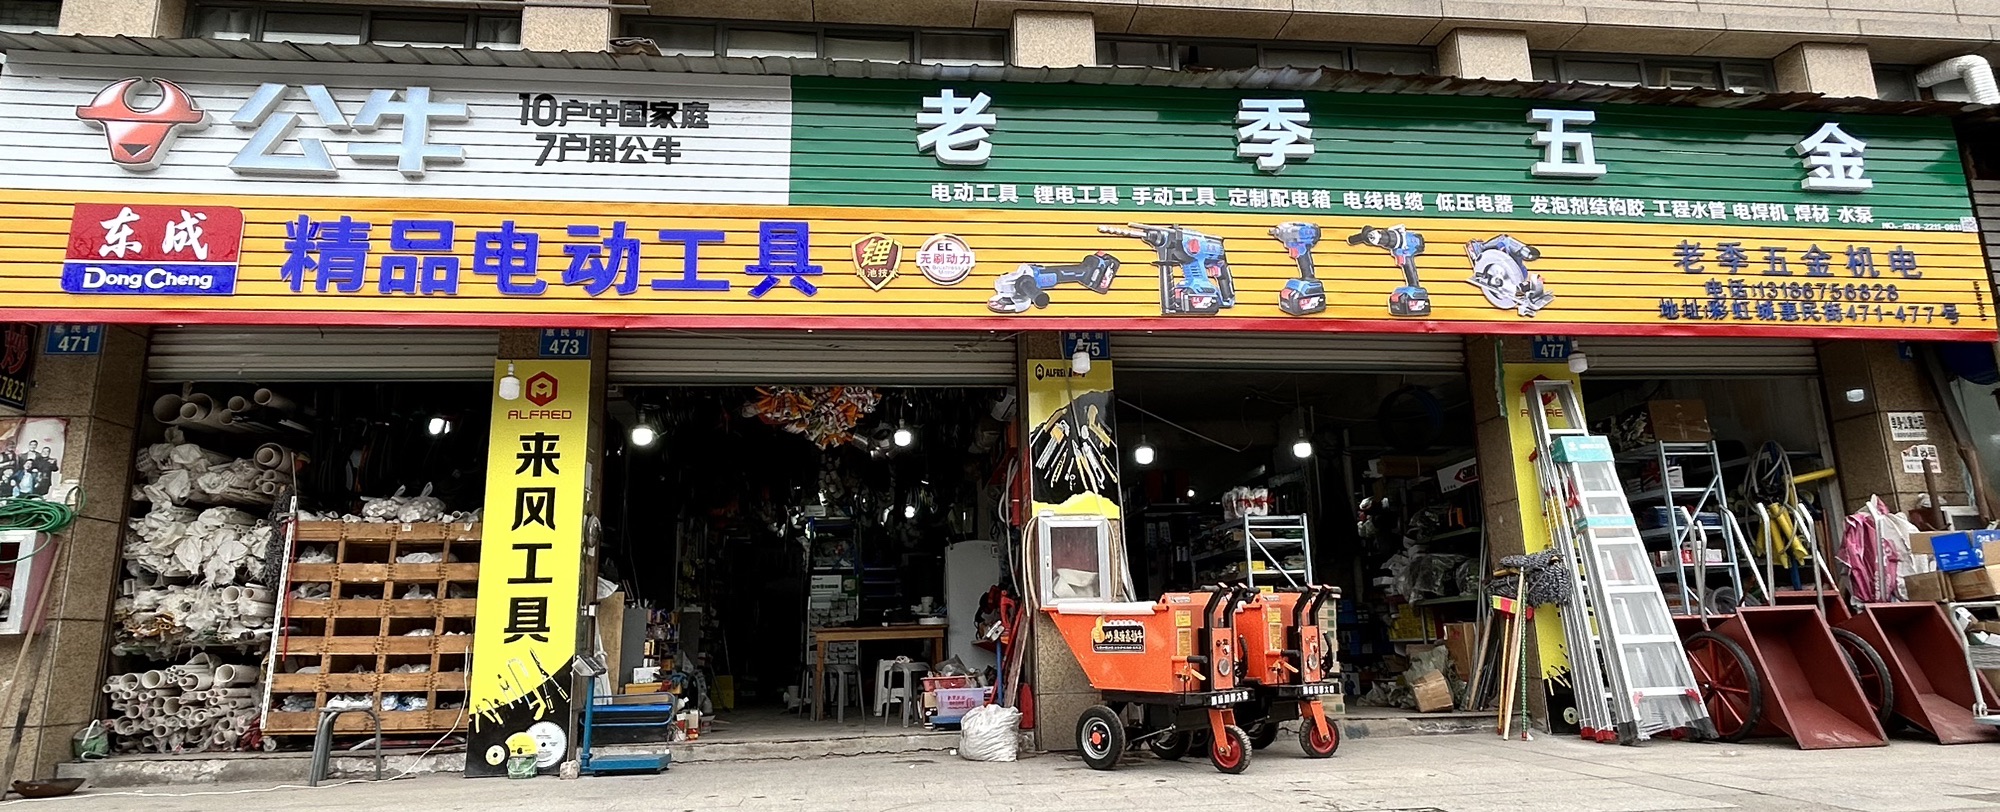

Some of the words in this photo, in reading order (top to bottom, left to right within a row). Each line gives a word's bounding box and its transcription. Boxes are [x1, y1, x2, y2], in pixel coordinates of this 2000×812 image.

[518, 92, 710, 129] 10户中国家庭
[228, 81, 470, 178] 公牛
[915, 88, 1874, 192] 老季五金
[535, 133, 682, 166] 7户用公牛
[931, 182, 1019, 205] 电动工具
[1033, 184, 1119, 207] 锂电工具
[1131, 186, 1217, 208] 手动工具
[1228, 189, 1331, 210] 定制配电箱
[1343, 190, 1425, 212] 电线电缆
[1436, 193, 1514, 214] 低压电器
[1530, 195, 1645, 218] 发泡剂结构胶
[1652, 199, 1727, 220] 工程水管
[1732, 202, 1788, 222] 电焊机
[1793, 204, 1831, 224] 焊材
[1837, 206, 1875, 225] 水泵
[99, 206, 209, 260] 东成
[937, 242, 953, 251] EC
[280, 214, 824, 298] 精品电动工具
[861, 238, 894, 267] 锂
[920, 253, 971, 265] 无刷动力
[1672, 239, 1923, 279] 老季五金机电
[856, 268, 900, 279] 电池技术
[57, 335, 90, 352] 471
[549, 339, 580, 354] 473
[1540, 344, 1564, 357] 477
[0, 374, 25, 402] 7823
[507, 409, 572, 420] ALFRED
[504, 431, 562, 644] 来风工具
